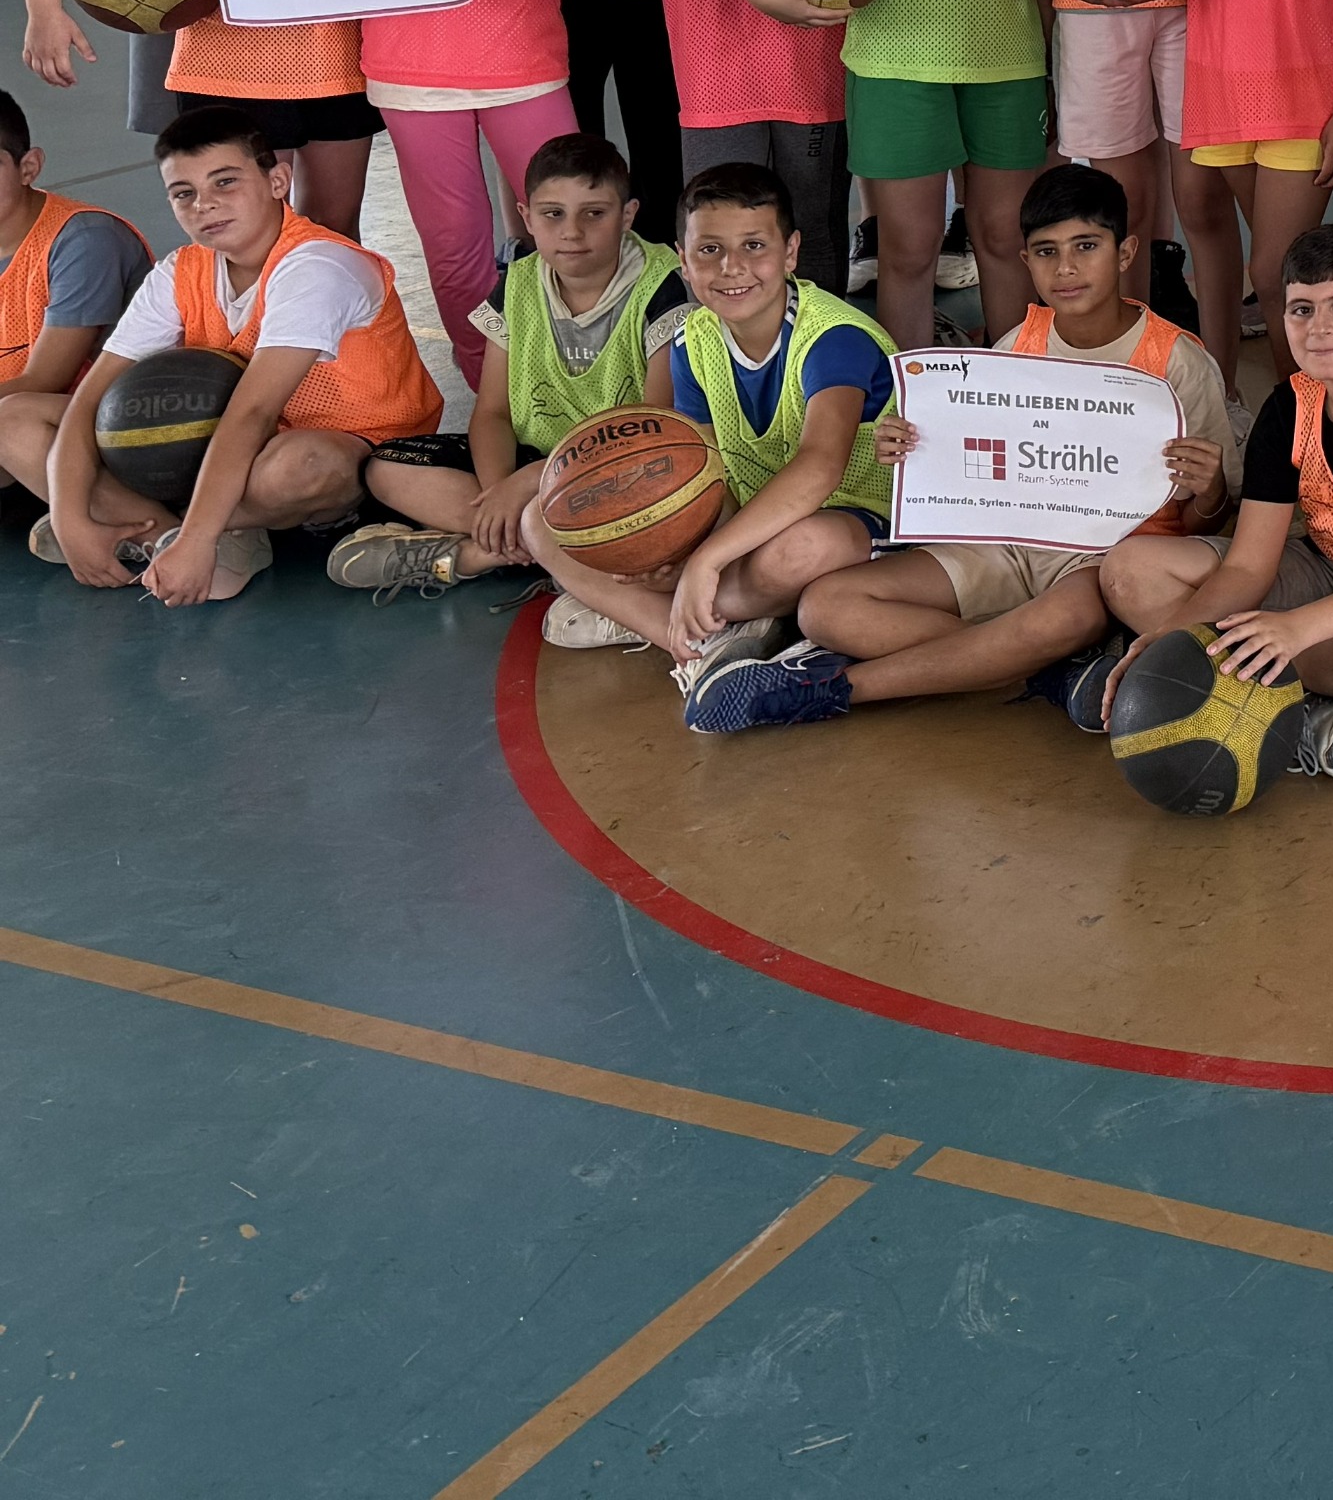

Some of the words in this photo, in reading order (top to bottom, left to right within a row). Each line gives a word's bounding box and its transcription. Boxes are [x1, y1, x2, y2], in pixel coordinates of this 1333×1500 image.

[948, 389, 1011, 407] VIELEN
[1015, 395, 1079, 411] LIEBEN
[1084, 399, 1135, 416] DANK
[1033, 419, 1049, 429] AN
[553, 418, 663, 476] molten
[1017, 441, 1119, 475] Strähle
[1017, 472, 1089, 487] Raum-Systeme
[905, 496, 925, 504] von
[979, 497, 1011, 509] Syrien
[1020, 501, 1044, 511] nach
